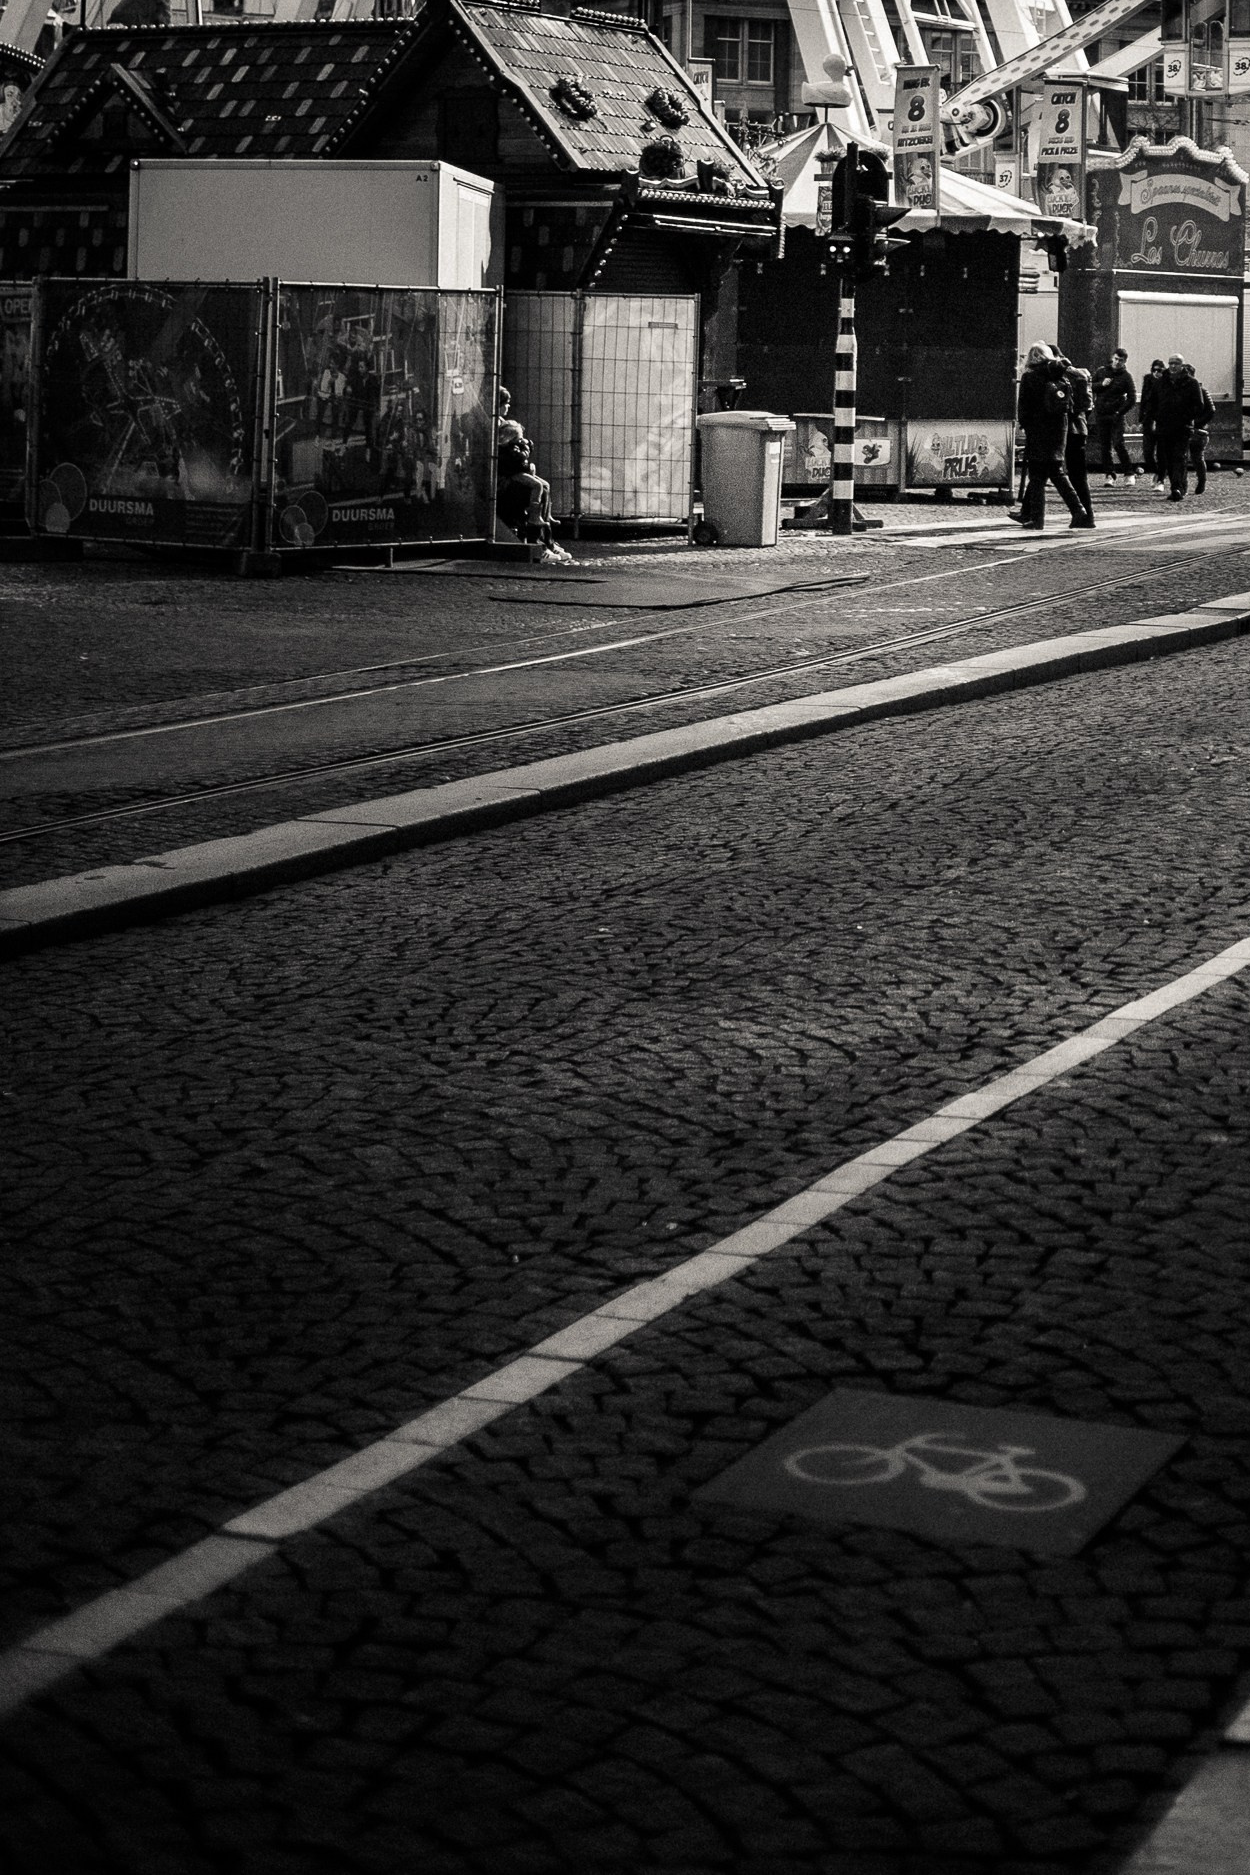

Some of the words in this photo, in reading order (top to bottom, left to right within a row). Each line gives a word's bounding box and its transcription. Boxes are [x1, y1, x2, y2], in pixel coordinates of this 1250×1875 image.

[1168, 64, 1178, 73] 38
[1235, 61, 1246, 71] 38
[907, 95, 926, 122] 8
[1055, 108, 1070, 135] 8
[812, 467, 832, 479] DUC
[89, 498, 154, 516] DUURSMA
[332, 507, 395, 522] DUURSMA
